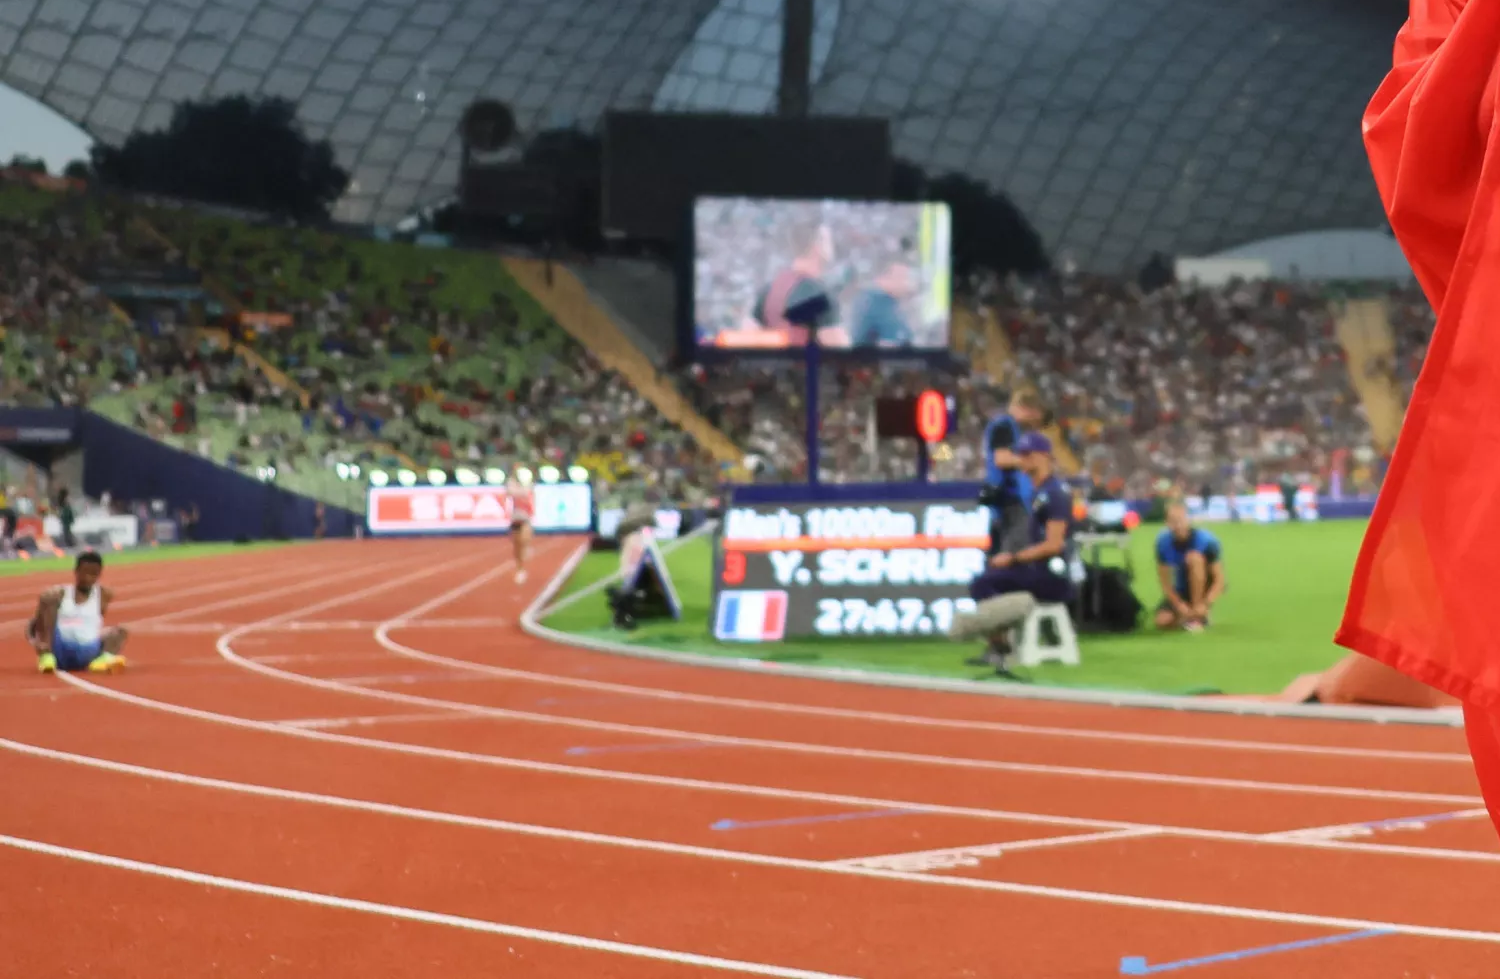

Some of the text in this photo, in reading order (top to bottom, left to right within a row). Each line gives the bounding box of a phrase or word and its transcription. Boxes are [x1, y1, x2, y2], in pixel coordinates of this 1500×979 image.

[916, 390, 947, 442] 0
[411, 493, 513, 520] SPA
[726, 505, 990, 538] Men's 10000m Final
[722, 551, 746, 584] 3
